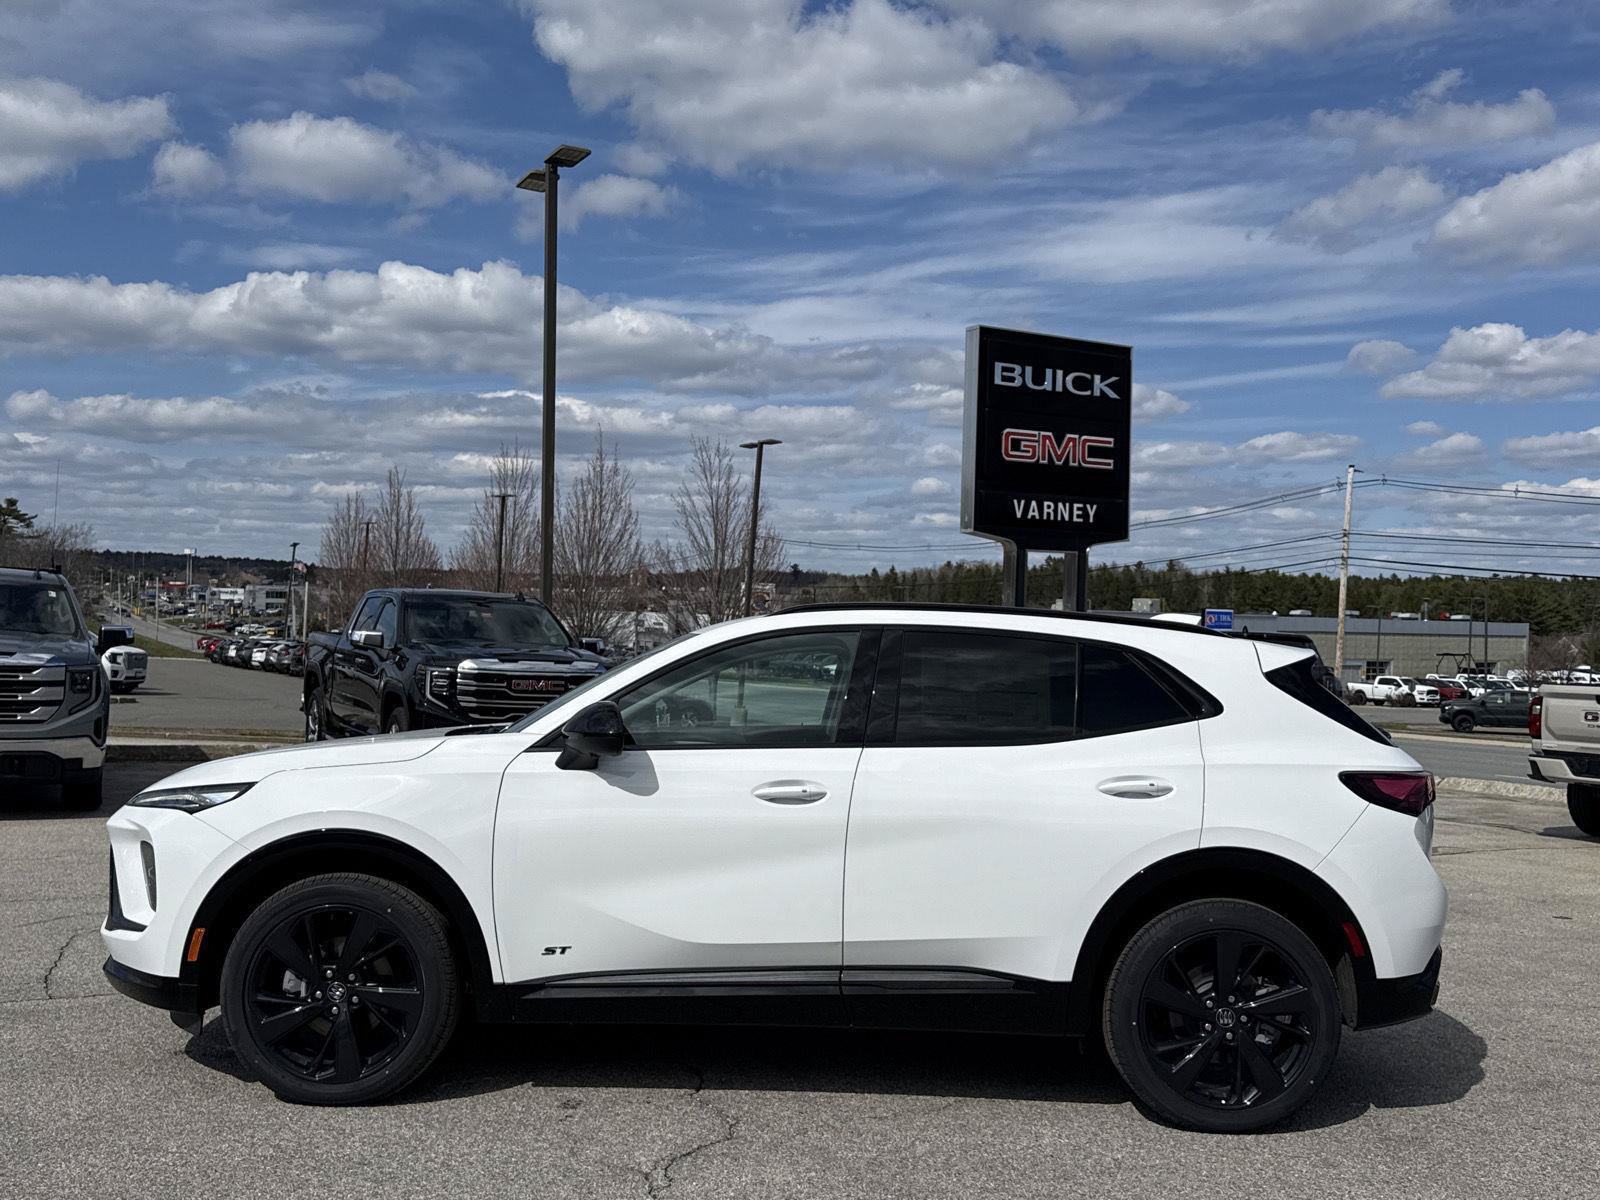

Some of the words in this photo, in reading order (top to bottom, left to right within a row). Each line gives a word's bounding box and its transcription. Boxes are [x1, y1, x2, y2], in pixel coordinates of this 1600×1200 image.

[994, 361, 1121, 399] BUICK
[1001, 428, 1114, 470] GMC
[1013, 499, 1098, 523] VARNEY
[512, 680, 565, 691] GMC
[541, 946, 573, 956] ST
